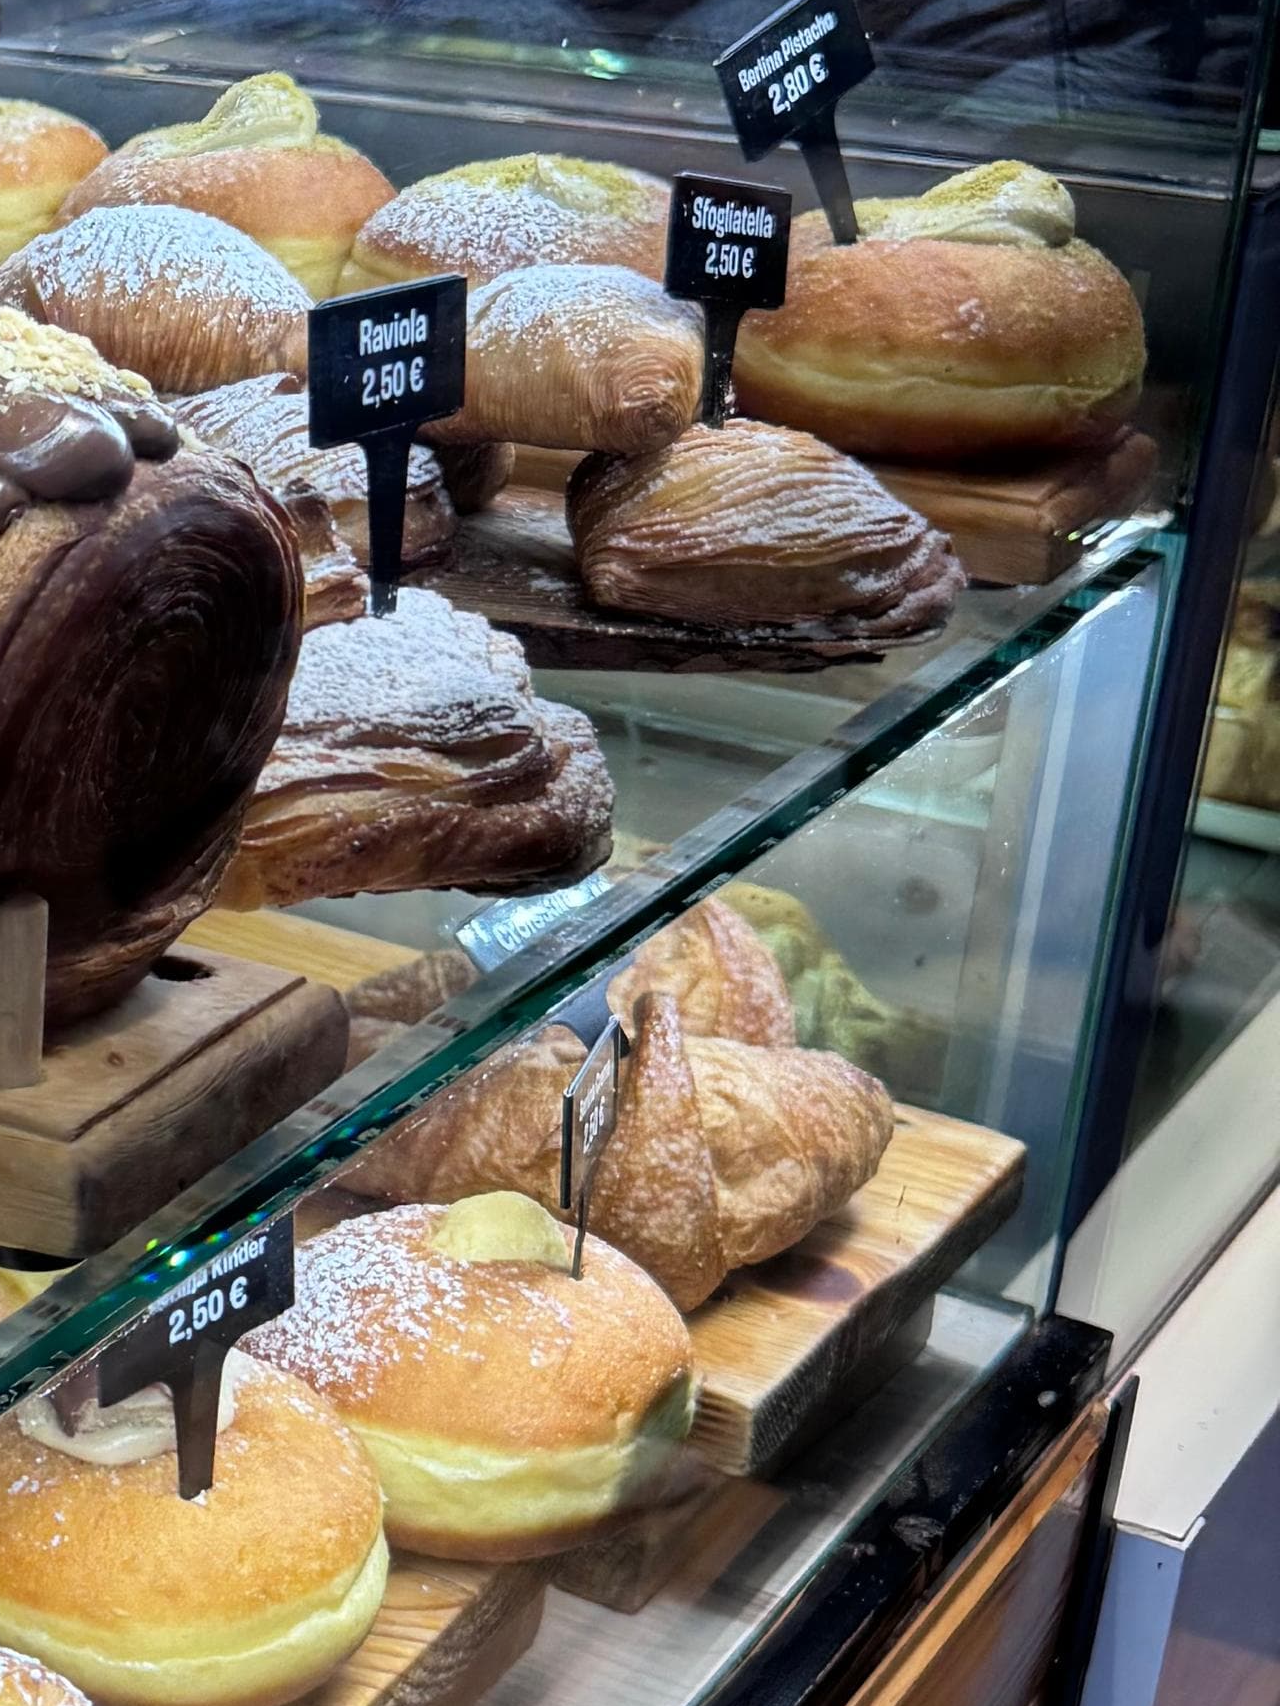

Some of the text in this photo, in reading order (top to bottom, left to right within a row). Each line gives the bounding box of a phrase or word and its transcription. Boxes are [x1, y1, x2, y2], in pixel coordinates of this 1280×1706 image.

[779, 10, 839, 62] Pistacho
[768, 52, 829, 116] 2,80 €
[691, 195, 775, 239] Sfogliatella
[704, 242, 755, 280] 2,50 €
[359, 307, 429, 357] Raviola
[361, 355, 425, 409] 2,50 €
[211, 1235, 269, 1281] Kinder
[168, 1287, 225, 1346] 2,50
[228, 1274, 249, 1310] €
